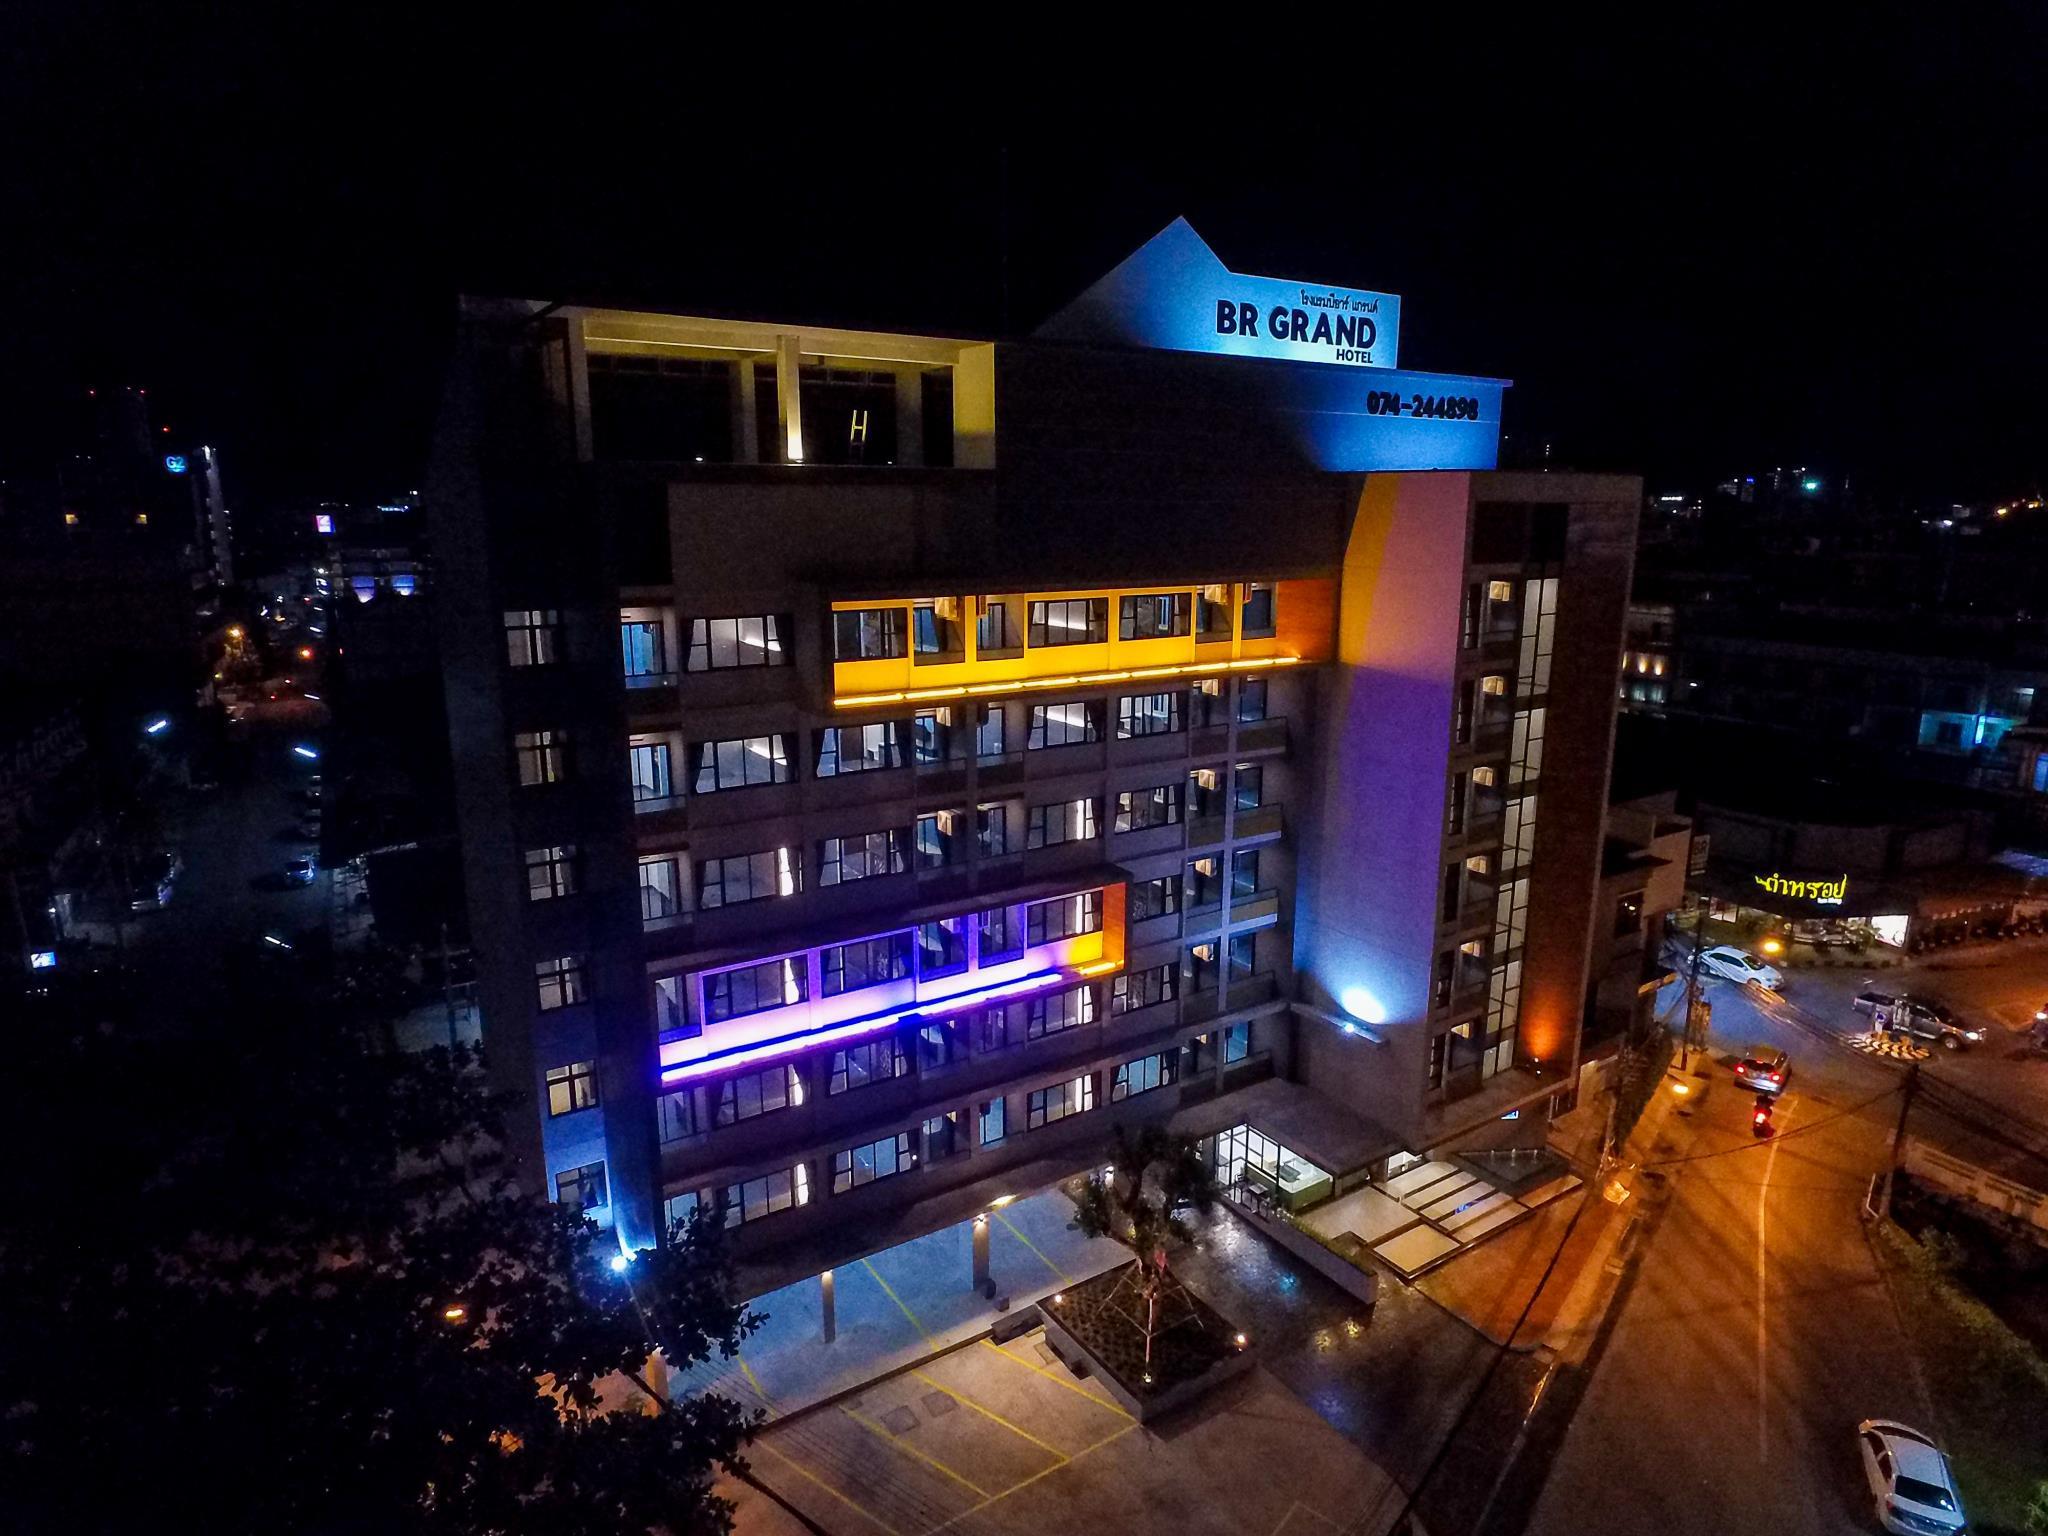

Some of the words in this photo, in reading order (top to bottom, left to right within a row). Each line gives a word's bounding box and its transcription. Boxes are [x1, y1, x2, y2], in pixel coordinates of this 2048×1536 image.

[1216, 299, 1259, 338] BR
[1268, 305, 1377, 349] GRAND
[1336, 349, 1374, 364] HOTEL
